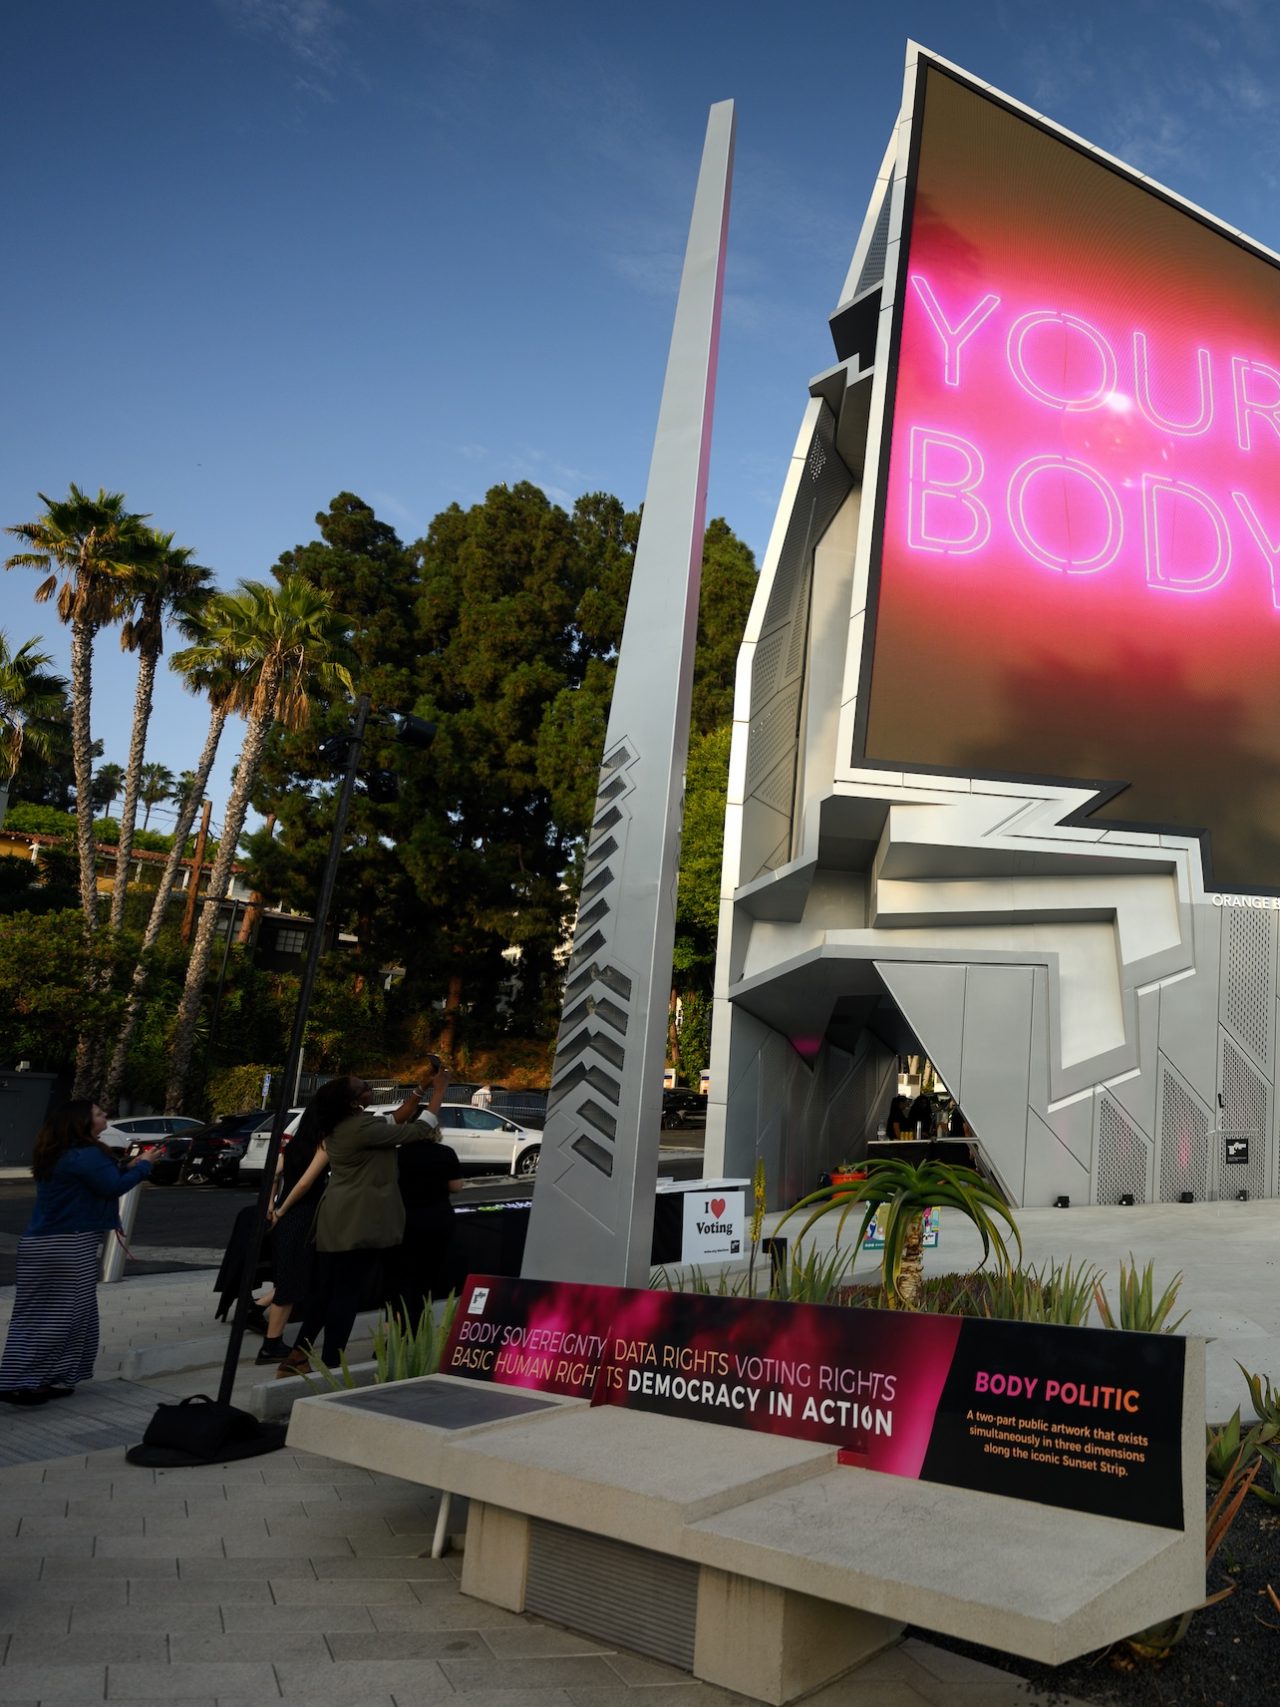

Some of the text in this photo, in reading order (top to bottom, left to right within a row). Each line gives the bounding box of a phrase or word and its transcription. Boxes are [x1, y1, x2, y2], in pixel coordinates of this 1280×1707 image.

[1212, 894, 1271, 909] ORANGE
[704, 1201, 709, 1214] I
[696, 1222, 733, 1235] Voting
[459, 1321, 897, 1401] BODY SOVEREIGNTY DATA RIGHTS VOTING RIGHTS
[451, 1346, 893, 1437] BASIC HUMAN RIGHTS DEMOCRACY IN ACTION
[975, 1371, 1140, 1413] BODY POLITIC
[967, 1409, 1149, 1446] A two-part public artwork that exists
[969, 1425, 1146, 1462] simultaneously in three dimensions
[984, 1442, 1128, 1477] along the iconic Sunset Strip.
